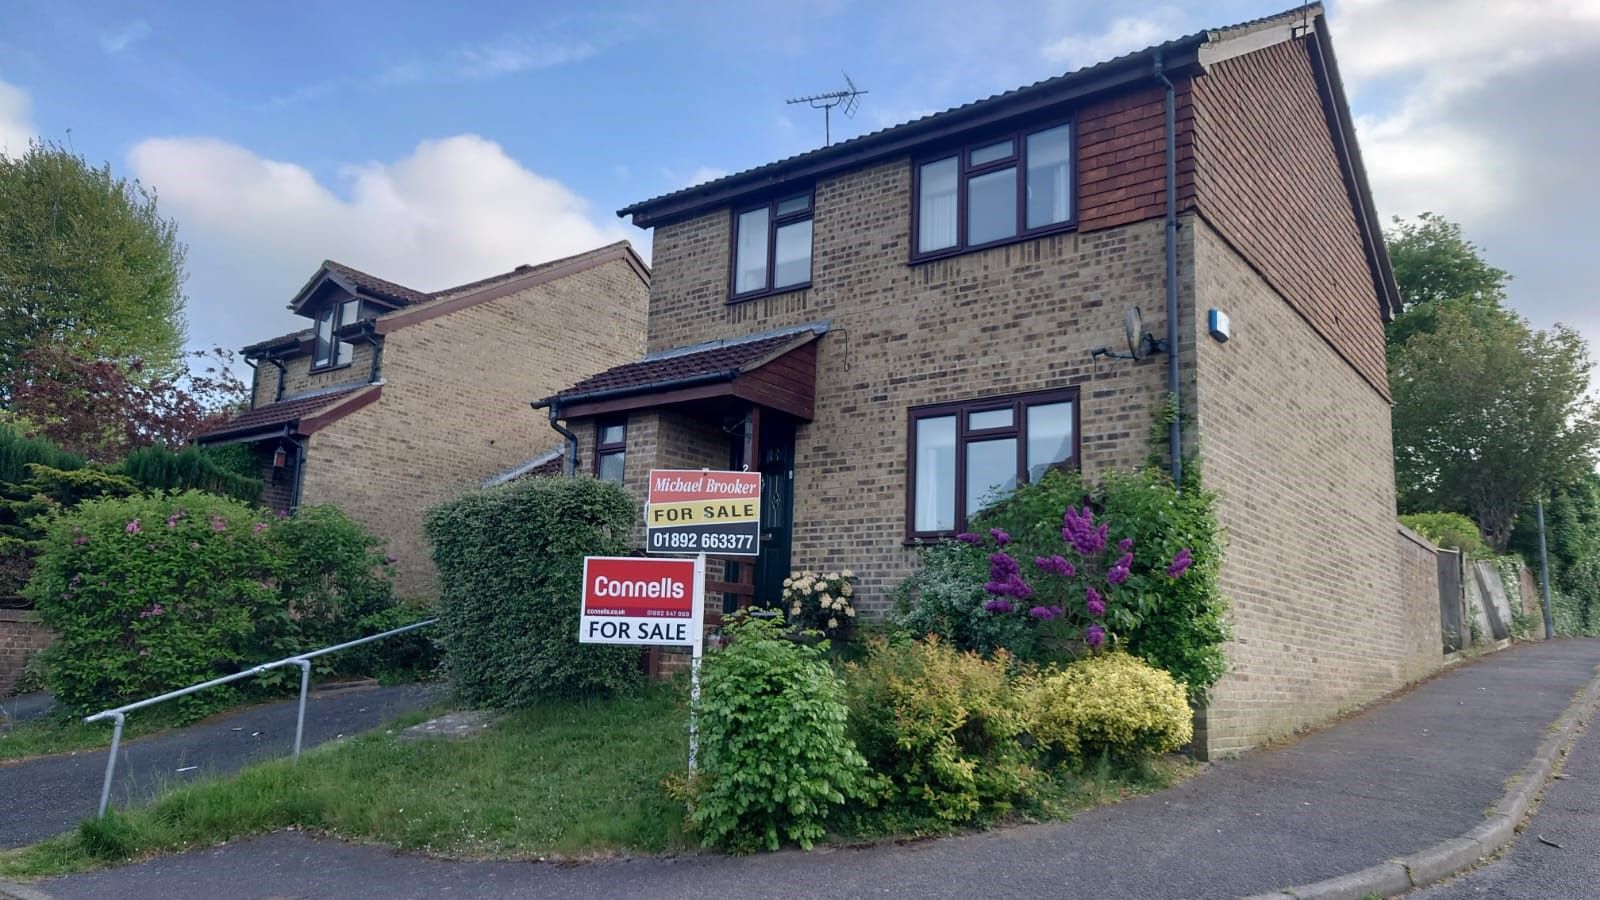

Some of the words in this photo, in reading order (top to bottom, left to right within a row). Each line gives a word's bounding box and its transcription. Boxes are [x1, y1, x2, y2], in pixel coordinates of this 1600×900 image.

[655, 478, 703, 492] Michael
[706, 479, 756, 494] Brooker
[654, 508, 693, 522] FOR
[704, 504, 754, 519] SALE
[654, 532, 697, 548] 01892
[701, 533, 753, 549] 663377
[594, 575, 685, 599] Connells
[589, 621, 630, 639] FOR
[638, 622, 687, 641] SALE
